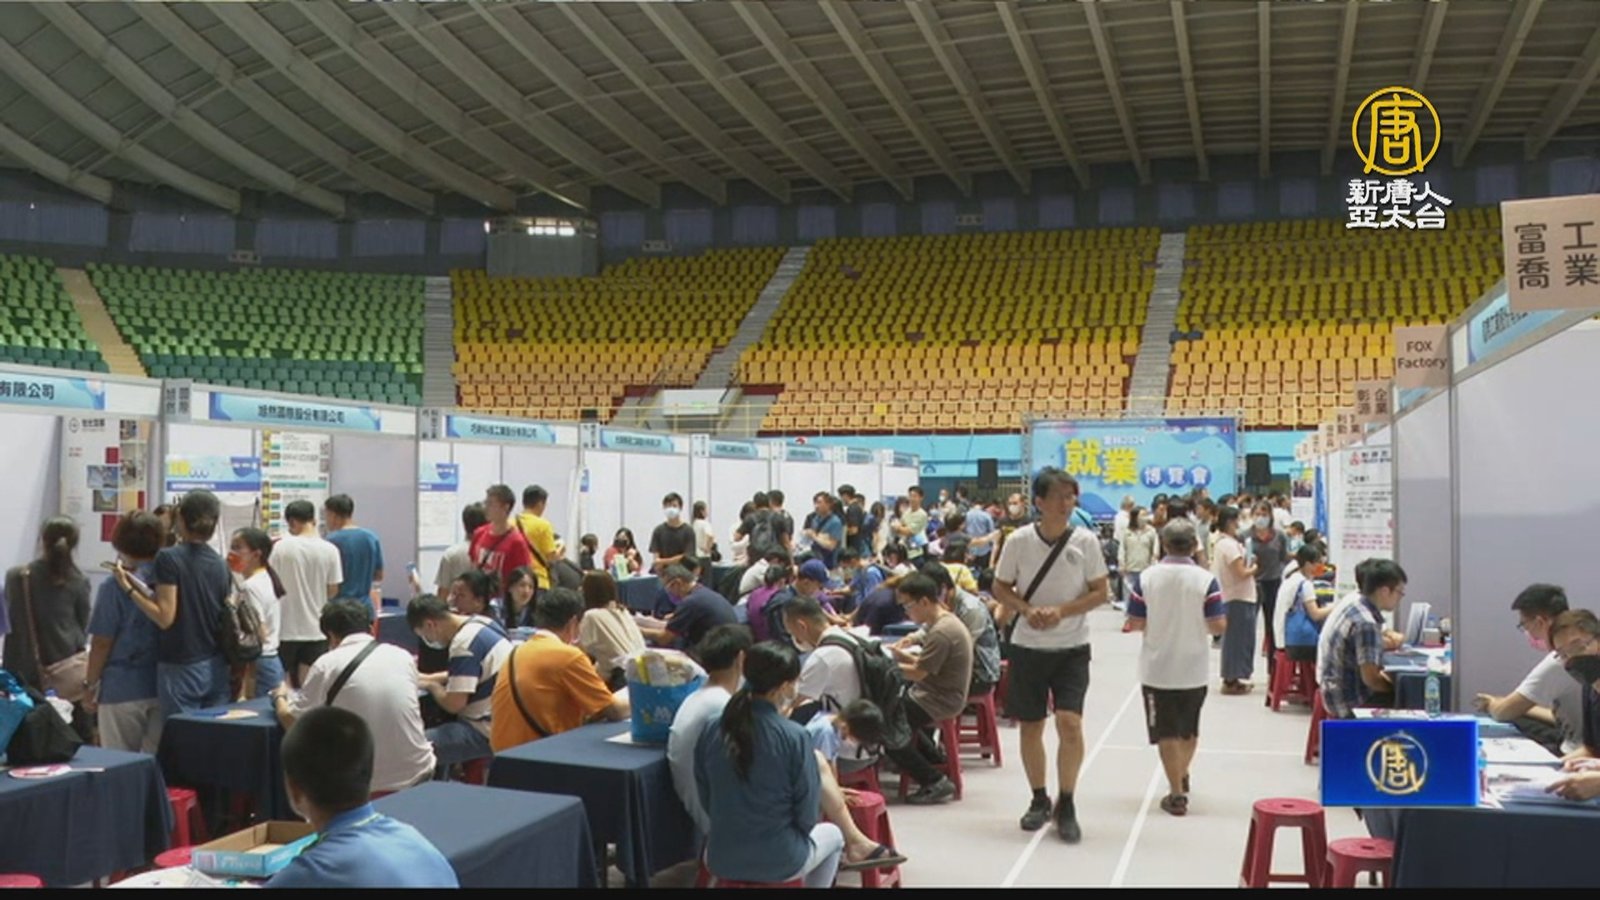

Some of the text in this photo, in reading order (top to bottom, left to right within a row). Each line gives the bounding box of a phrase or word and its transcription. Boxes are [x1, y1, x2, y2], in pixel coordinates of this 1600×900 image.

[1514, 222, 1550, 290] 富喬
[1562, 221, 1600, 287] 工業
[1406, 341, 1432, 353] FOX
[1397, 357, 1448, 371] Factory
[0, 380, 55, 401] 有限公司
[1375, 388, 1387, 415] 企業
[1064, 437, 1139, 486] 就業
[1143, 466, 1210, 487] 博覽會
